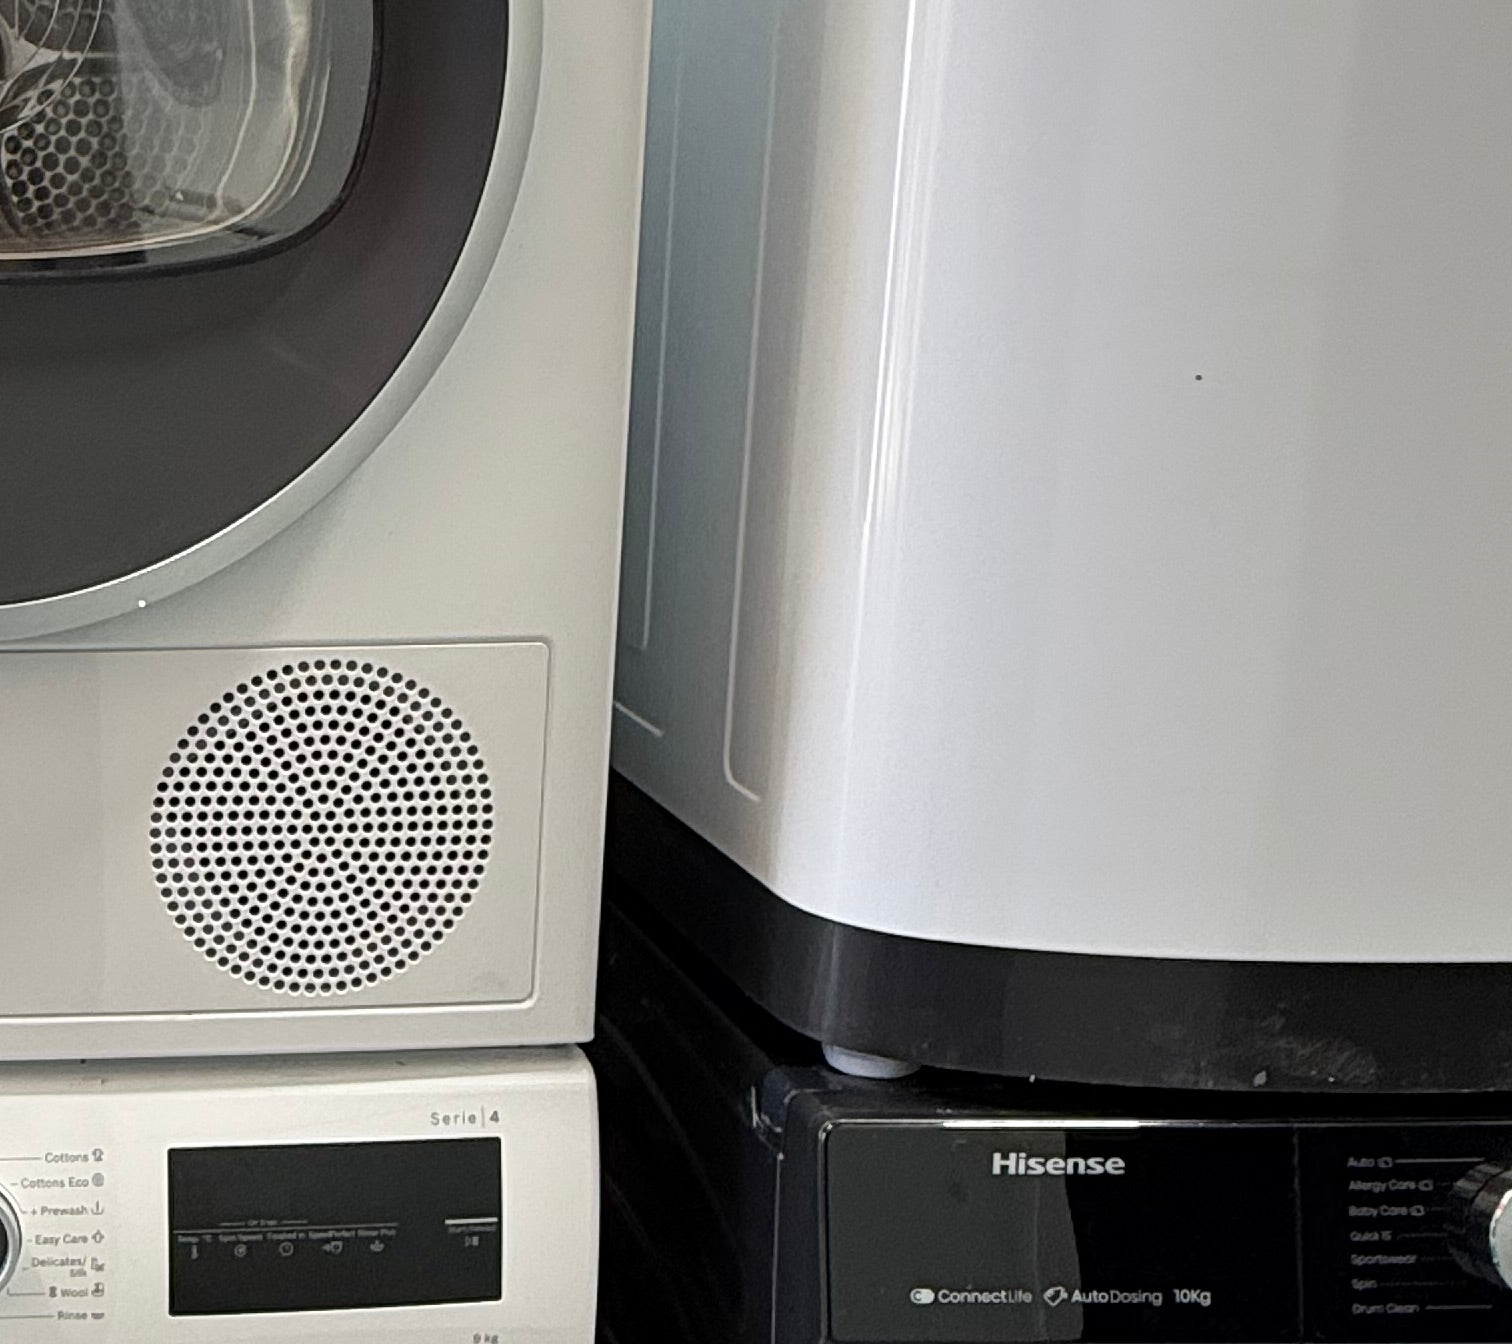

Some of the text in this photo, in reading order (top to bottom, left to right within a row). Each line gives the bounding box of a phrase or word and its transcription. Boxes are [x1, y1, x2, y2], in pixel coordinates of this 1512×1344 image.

[489, 1109, 500, 1124] 4
[992, 1152, 1126, 1176] Hisense
[20, 1176, 90, 1188] Cottons Eco
[40, 1205, 89, 1216] Prewash
[34, 1234, 89, 1247] Easy Care
[938, 1288, 1212, 1307] ConnectLife AutoDosing 10Kg
